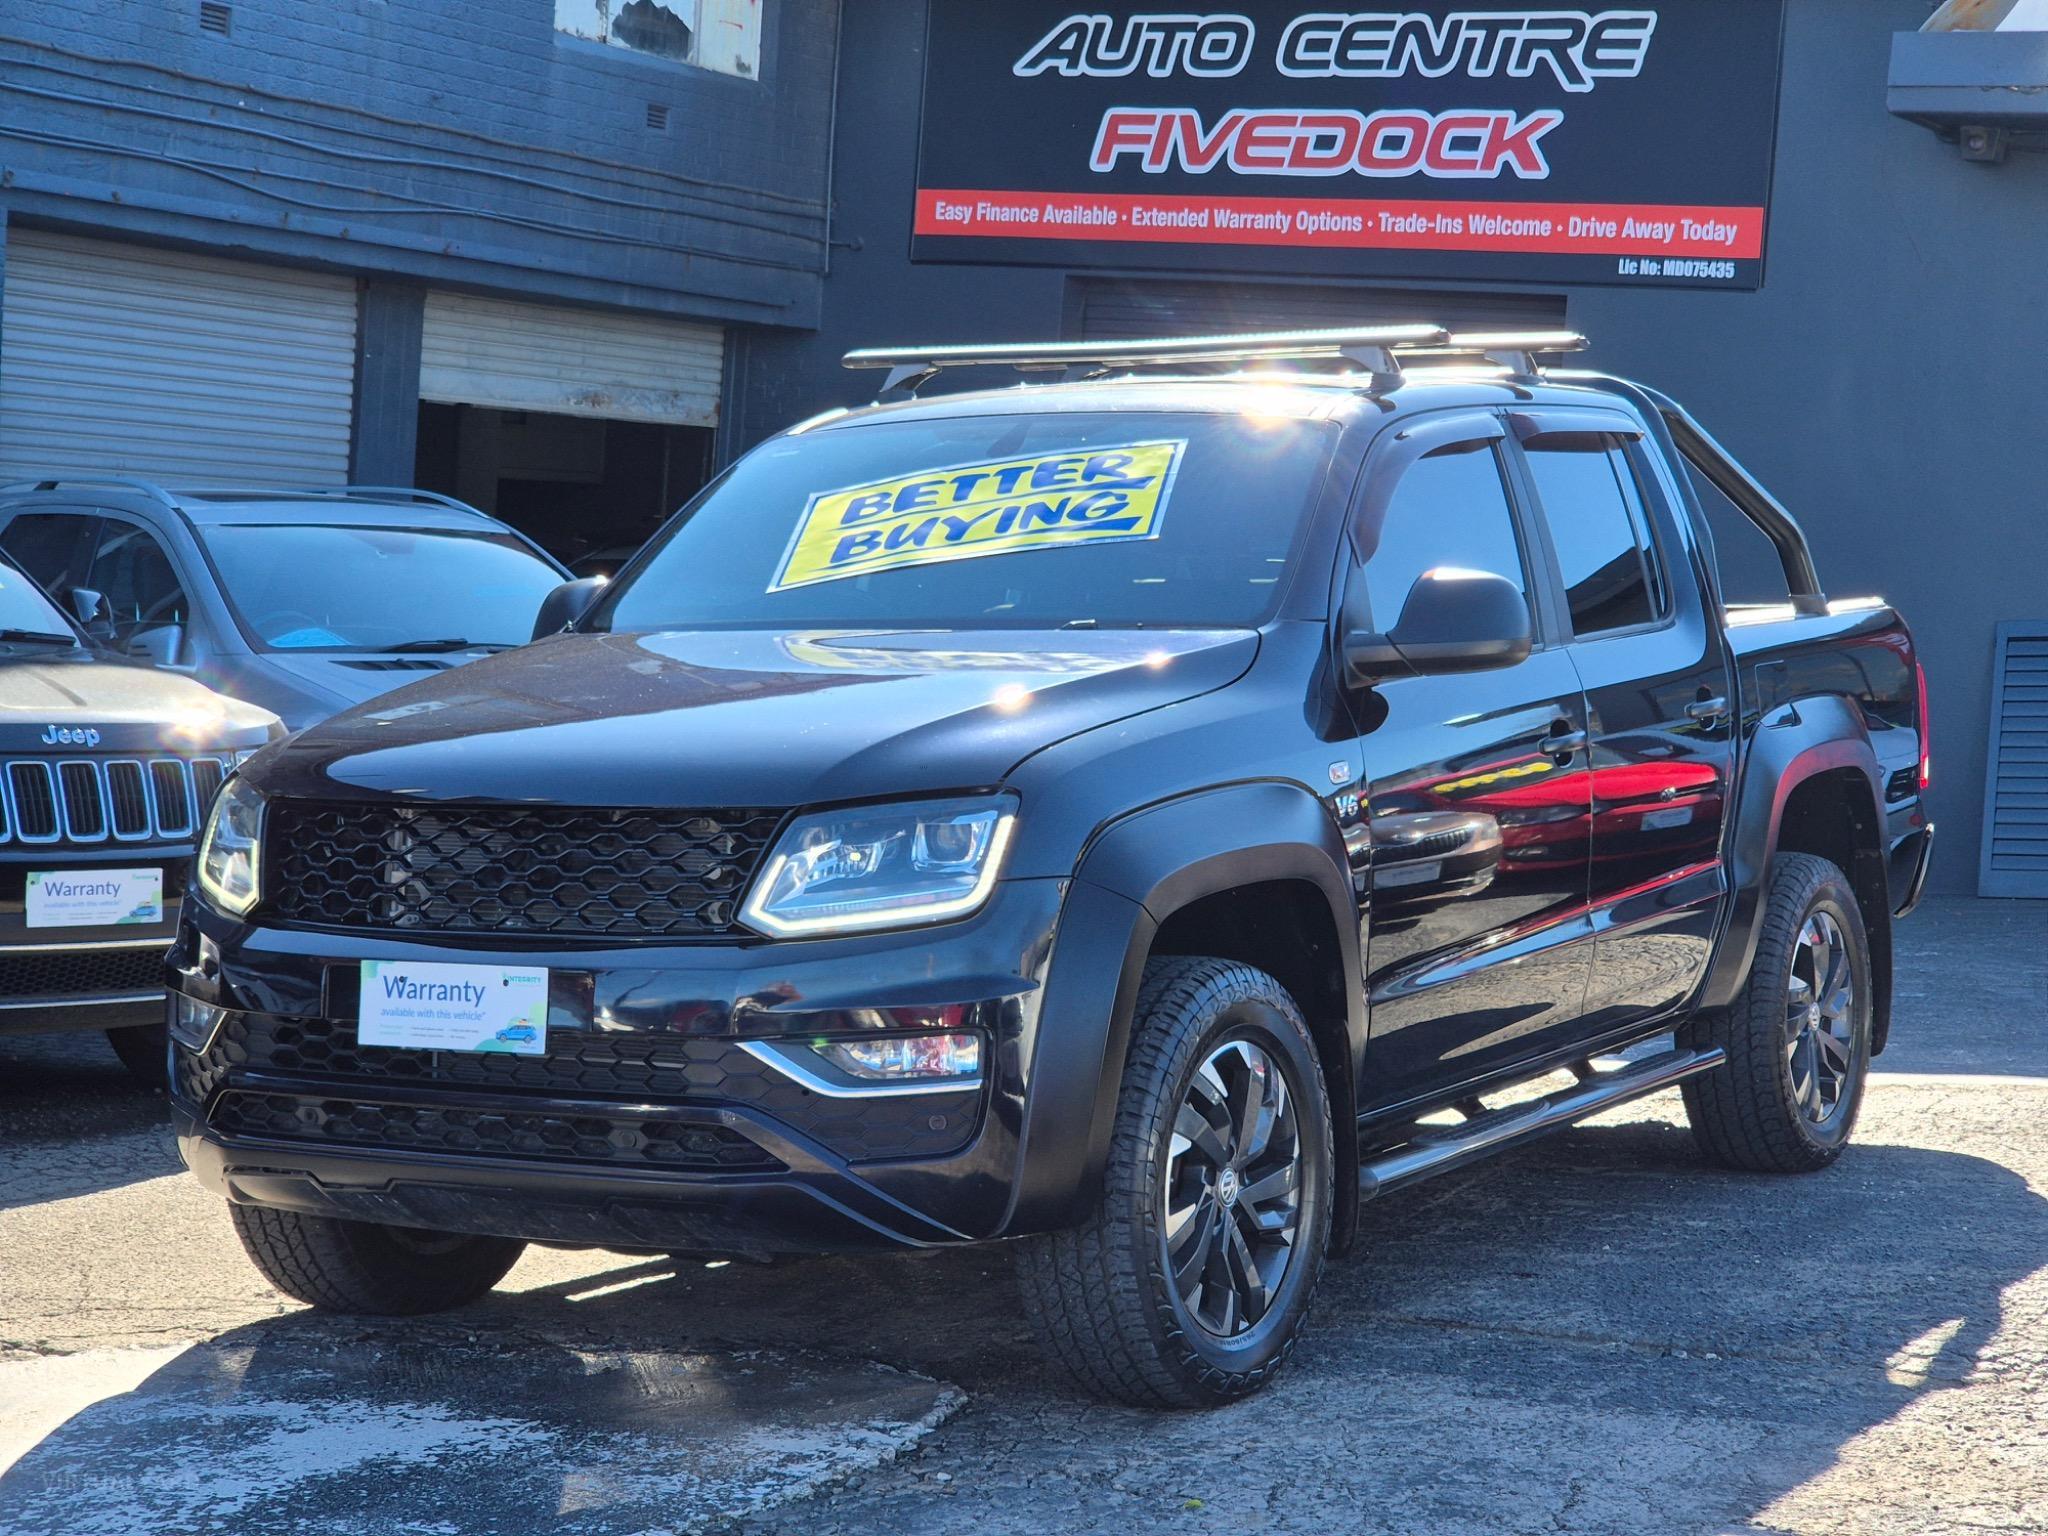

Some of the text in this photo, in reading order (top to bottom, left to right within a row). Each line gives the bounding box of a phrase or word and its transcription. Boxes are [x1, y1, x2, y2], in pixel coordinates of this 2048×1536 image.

[1014, 10, 1657, 92] AUTO CENTRE
[1090, 107, 1563, 178] FIVEDOCK
[935, 201, 1737, 246] Easy Finance Available Extended Warranty Options Trade-Ins Welcome Drive Away Today
[1618, 258, 1735, 278] Lic No: MD075435
[840, 453, 1133, 526] BETTER
[829, 491, 1130, 564] BUYING
[41, 724, 100, 747] Jeep
[1334, 794, 1359, 818] V6
[45, 881, 121, 898] Warranty
[383, 975, 486, 1008] Warranty
[380, 1007, 415, 1018] available
[417, 1008, 435, 1019] with
[436, 1009, 452, 1020] this
